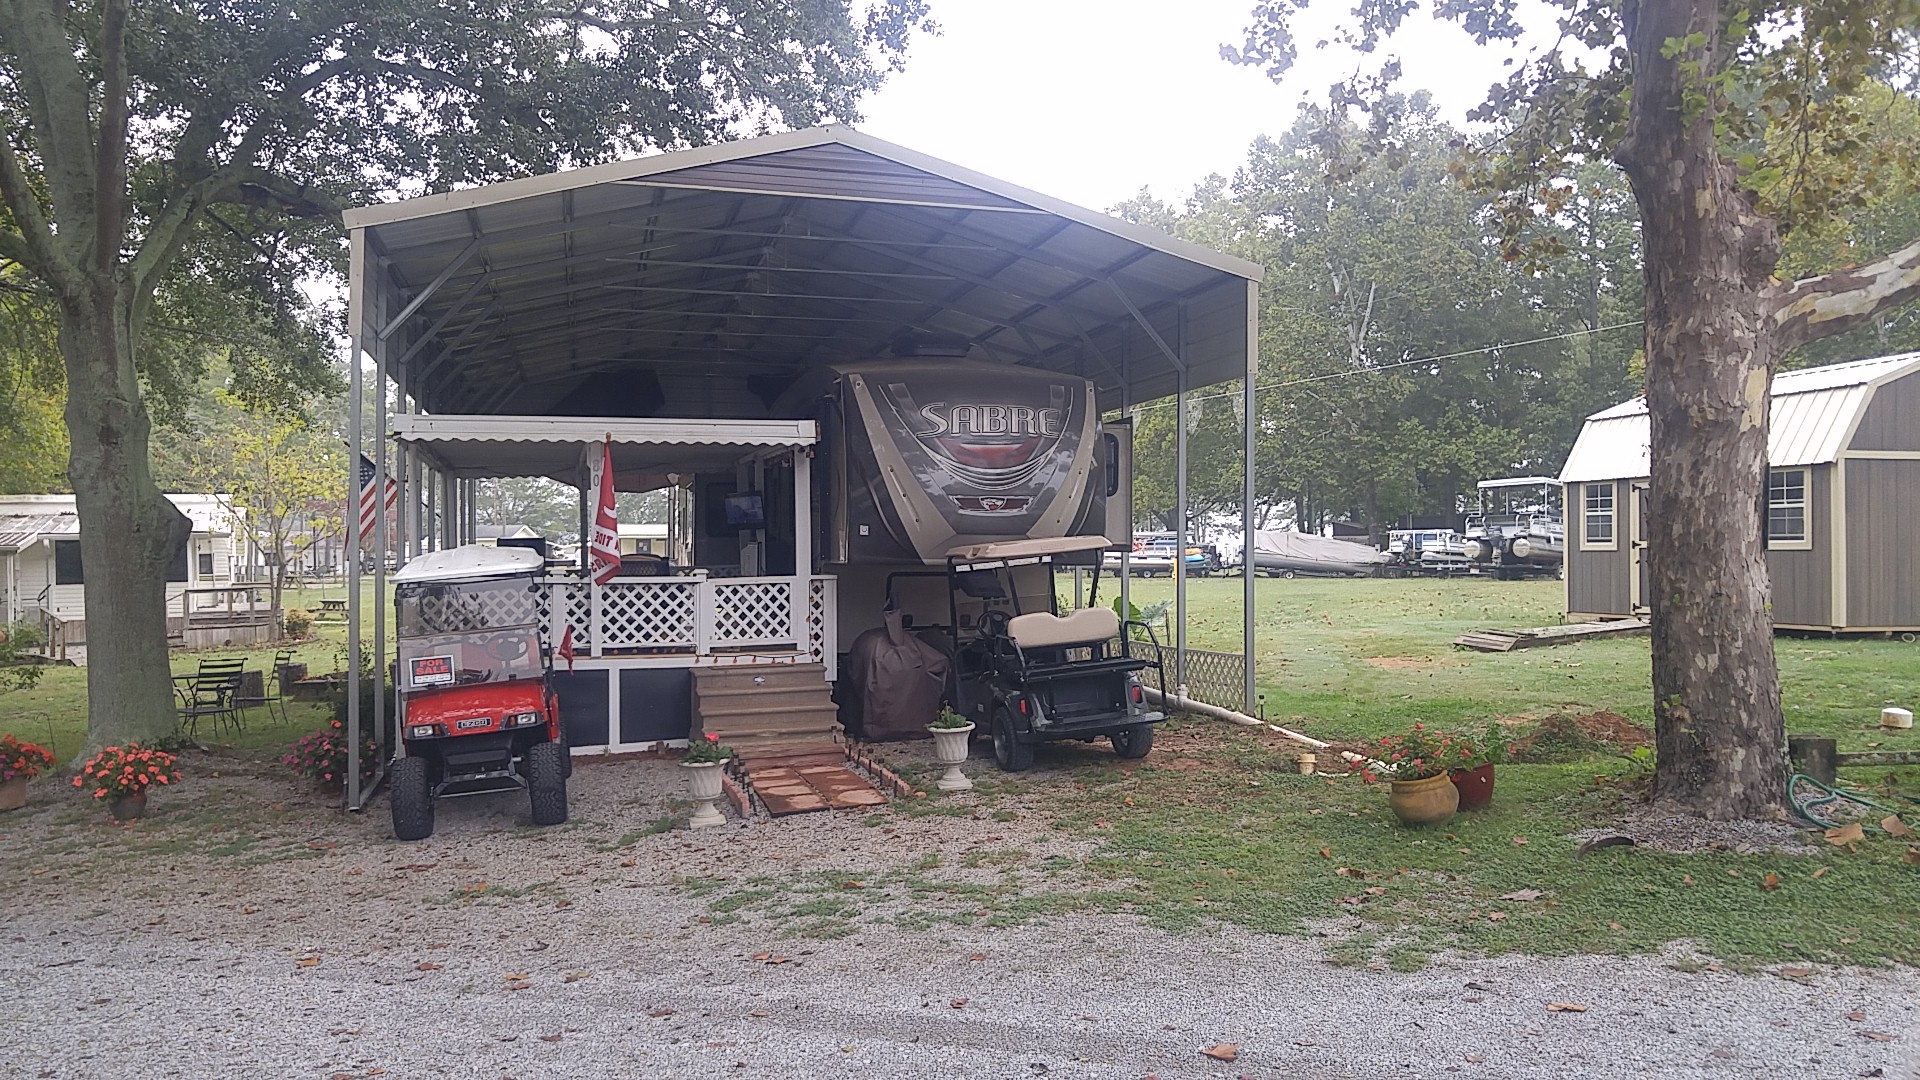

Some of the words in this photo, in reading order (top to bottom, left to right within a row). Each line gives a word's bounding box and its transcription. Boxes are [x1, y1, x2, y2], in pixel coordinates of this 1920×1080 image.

[916, 402, 1060, 438] SABRE
[419, 658, 443, 667] FOR
[415, 665, 449, 675] SALE
